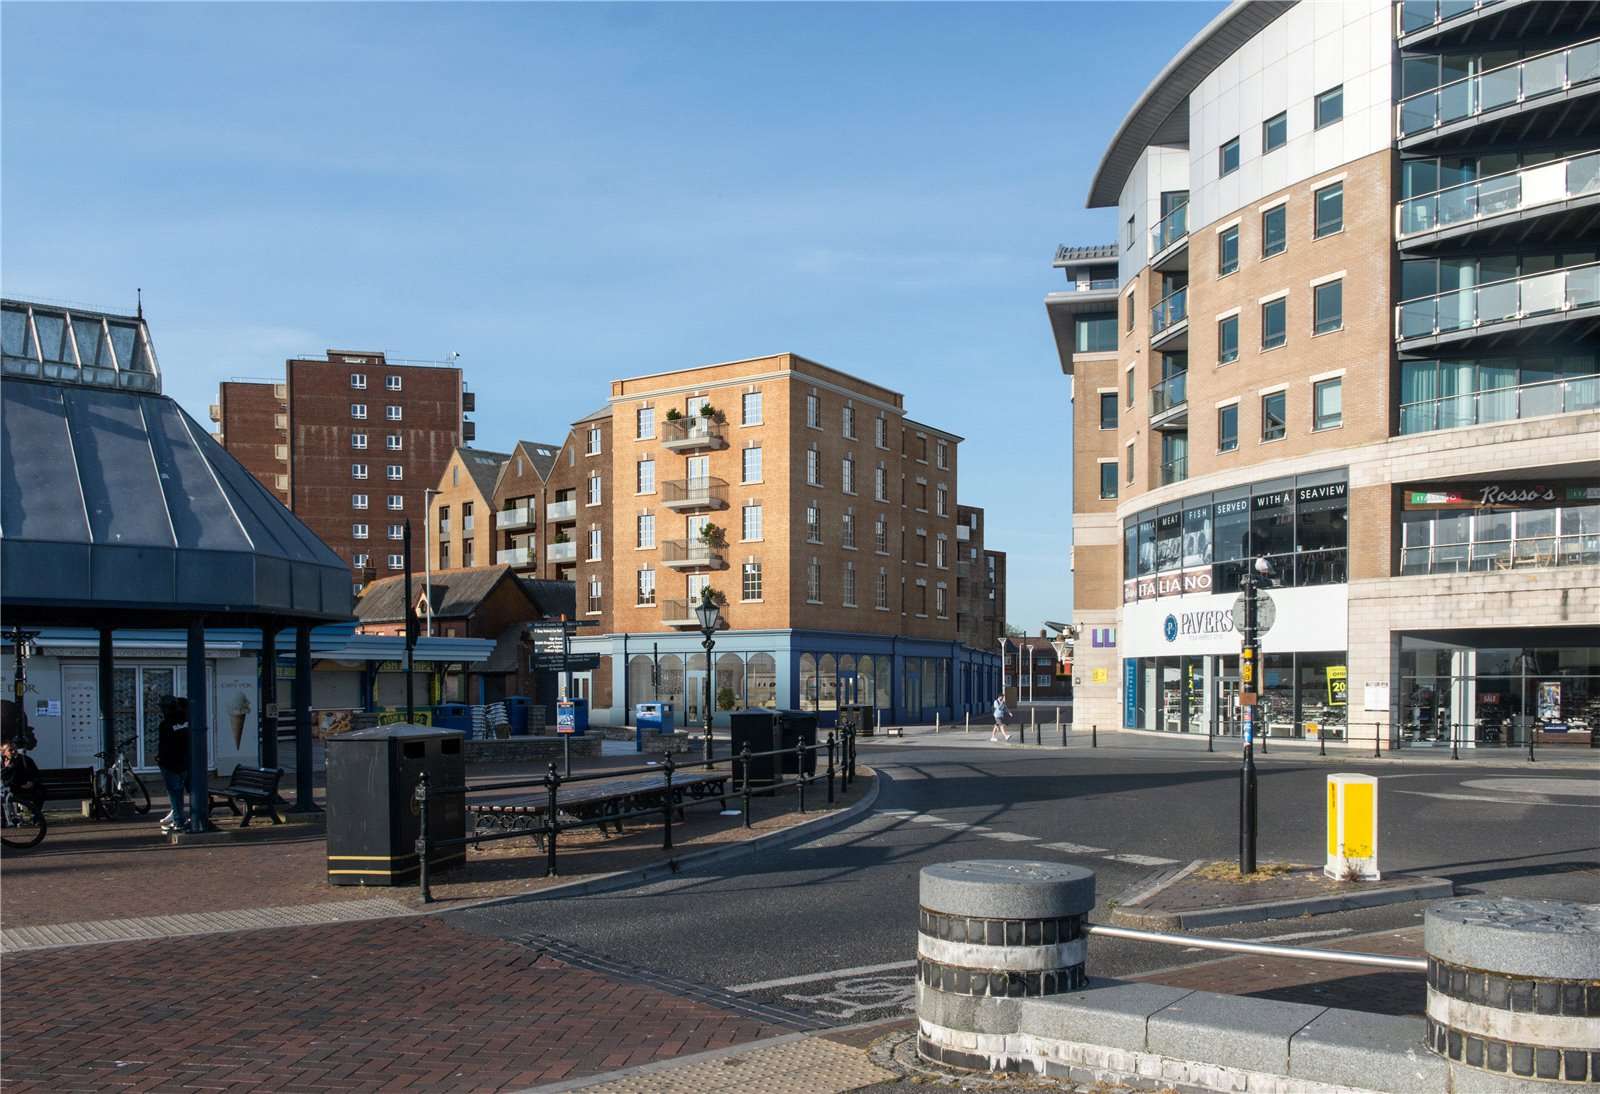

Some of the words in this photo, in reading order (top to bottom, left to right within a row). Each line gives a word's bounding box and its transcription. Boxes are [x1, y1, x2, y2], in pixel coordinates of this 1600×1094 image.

[1479, 485, 1556, 504] Rosso's
[1162, 514, 1179, 526] MEAT
[1188, 508, 1207, 520] FISH
[1217, 500, 1247, 514] SERVED
[1257, 495, 1281, 507] WITH
[1283, 493, 1290, 502] A
[1180, 609, 1234, 634] PAVERS
